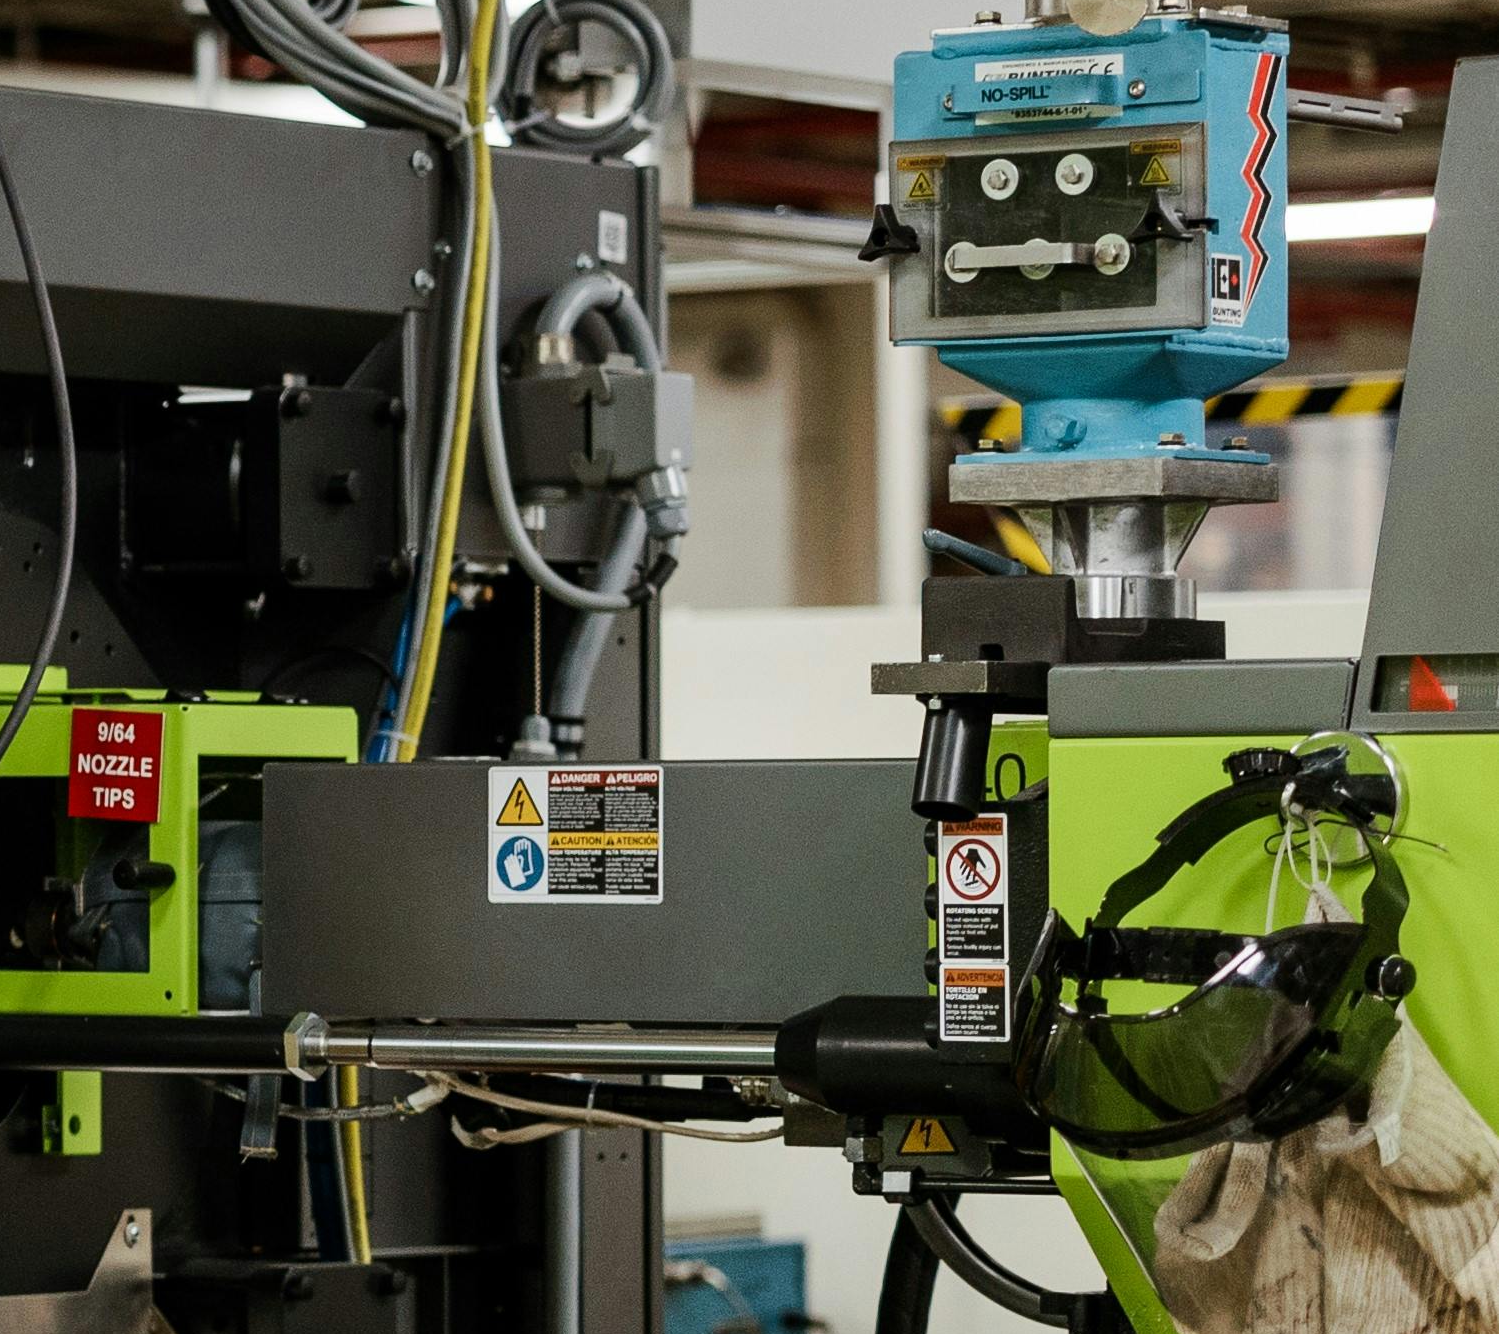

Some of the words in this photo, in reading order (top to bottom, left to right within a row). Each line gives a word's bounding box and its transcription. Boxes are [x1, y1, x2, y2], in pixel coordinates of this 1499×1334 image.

[1213, 307, 1240, 318] BUNTING
[98, 722, 135, 744] 9/64
[78, 753, 152, 778] NOZZLE
[562, 773, 600, 784] DANGER
[616, 773, 657, 784] PELIGRO
[93, 787, 135, 809] TIPS
[956, 821, 1001, 832] WARNING
[561, 836, 602, 845] CAUTION
[616, 834, 658, 845] ATENCIÓN
[956, 973, 1004, 983] ADVERTENCIA
